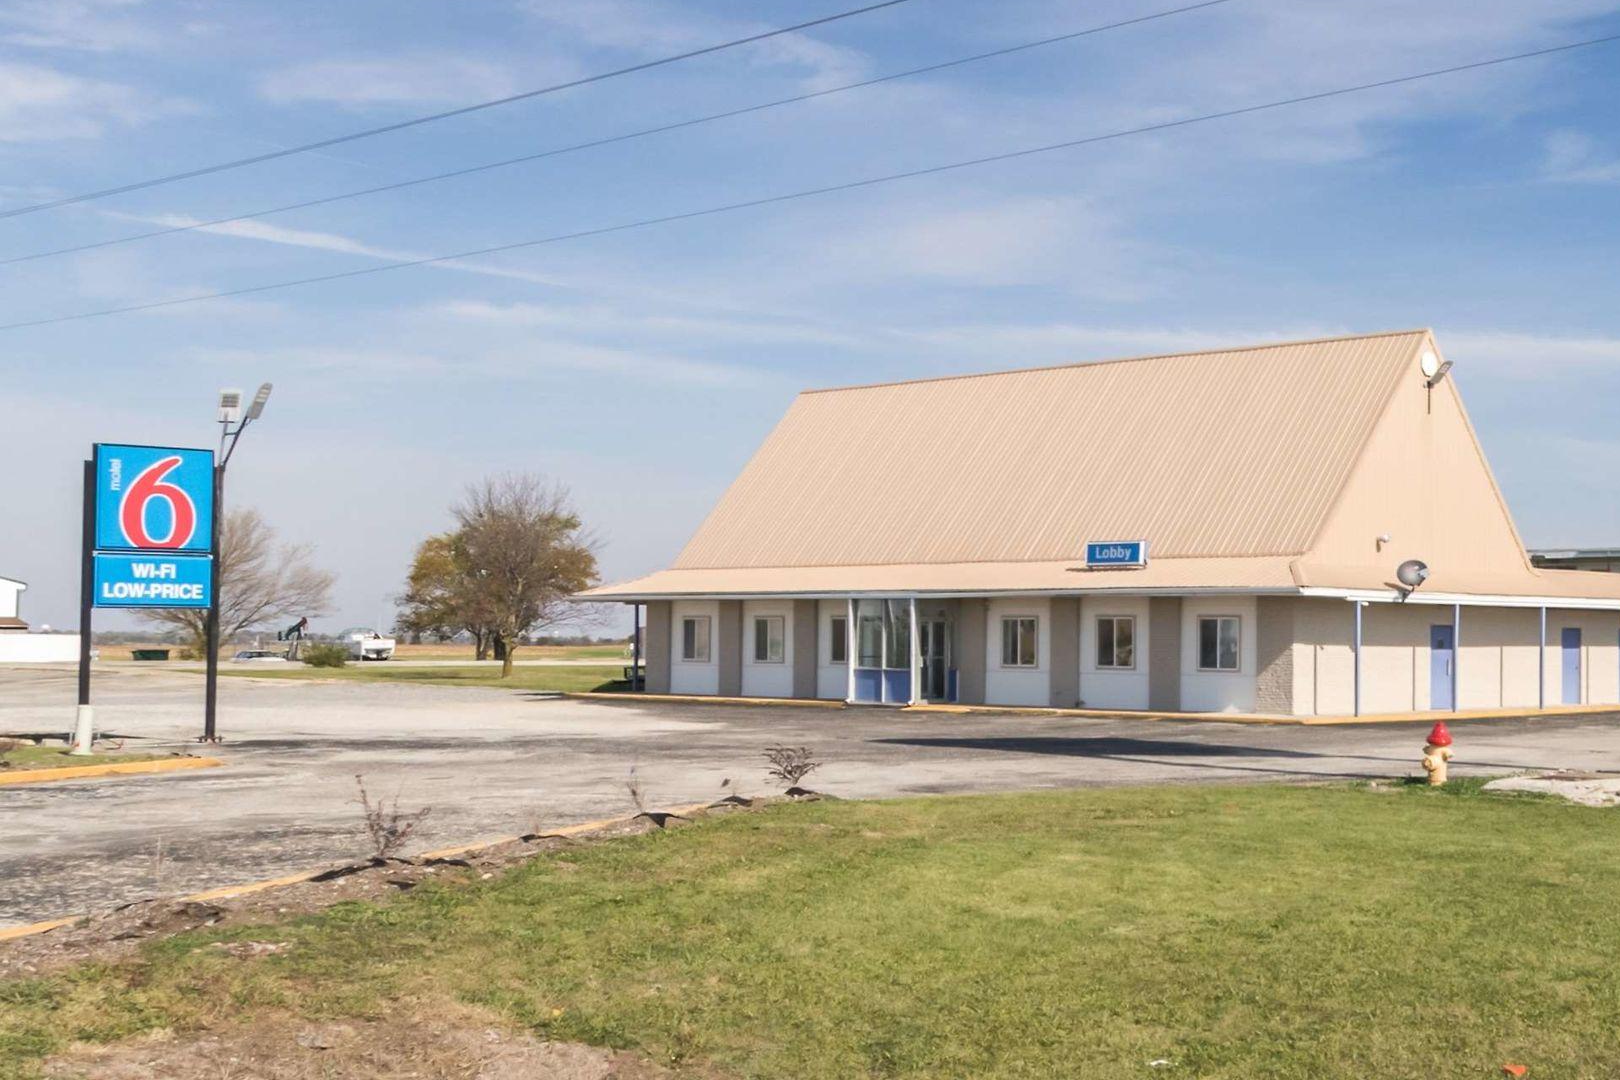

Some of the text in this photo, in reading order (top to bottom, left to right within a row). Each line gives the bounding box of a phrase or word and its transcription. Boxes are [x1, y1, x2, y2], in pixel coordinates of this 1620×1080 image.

[109, 456, 196, 549] motel 6
[1095, 546, 1132, 560] Lobby
[131, 563, 176, 579] WI-FI
[103, 582, 204, 599] LOW-PRICE
